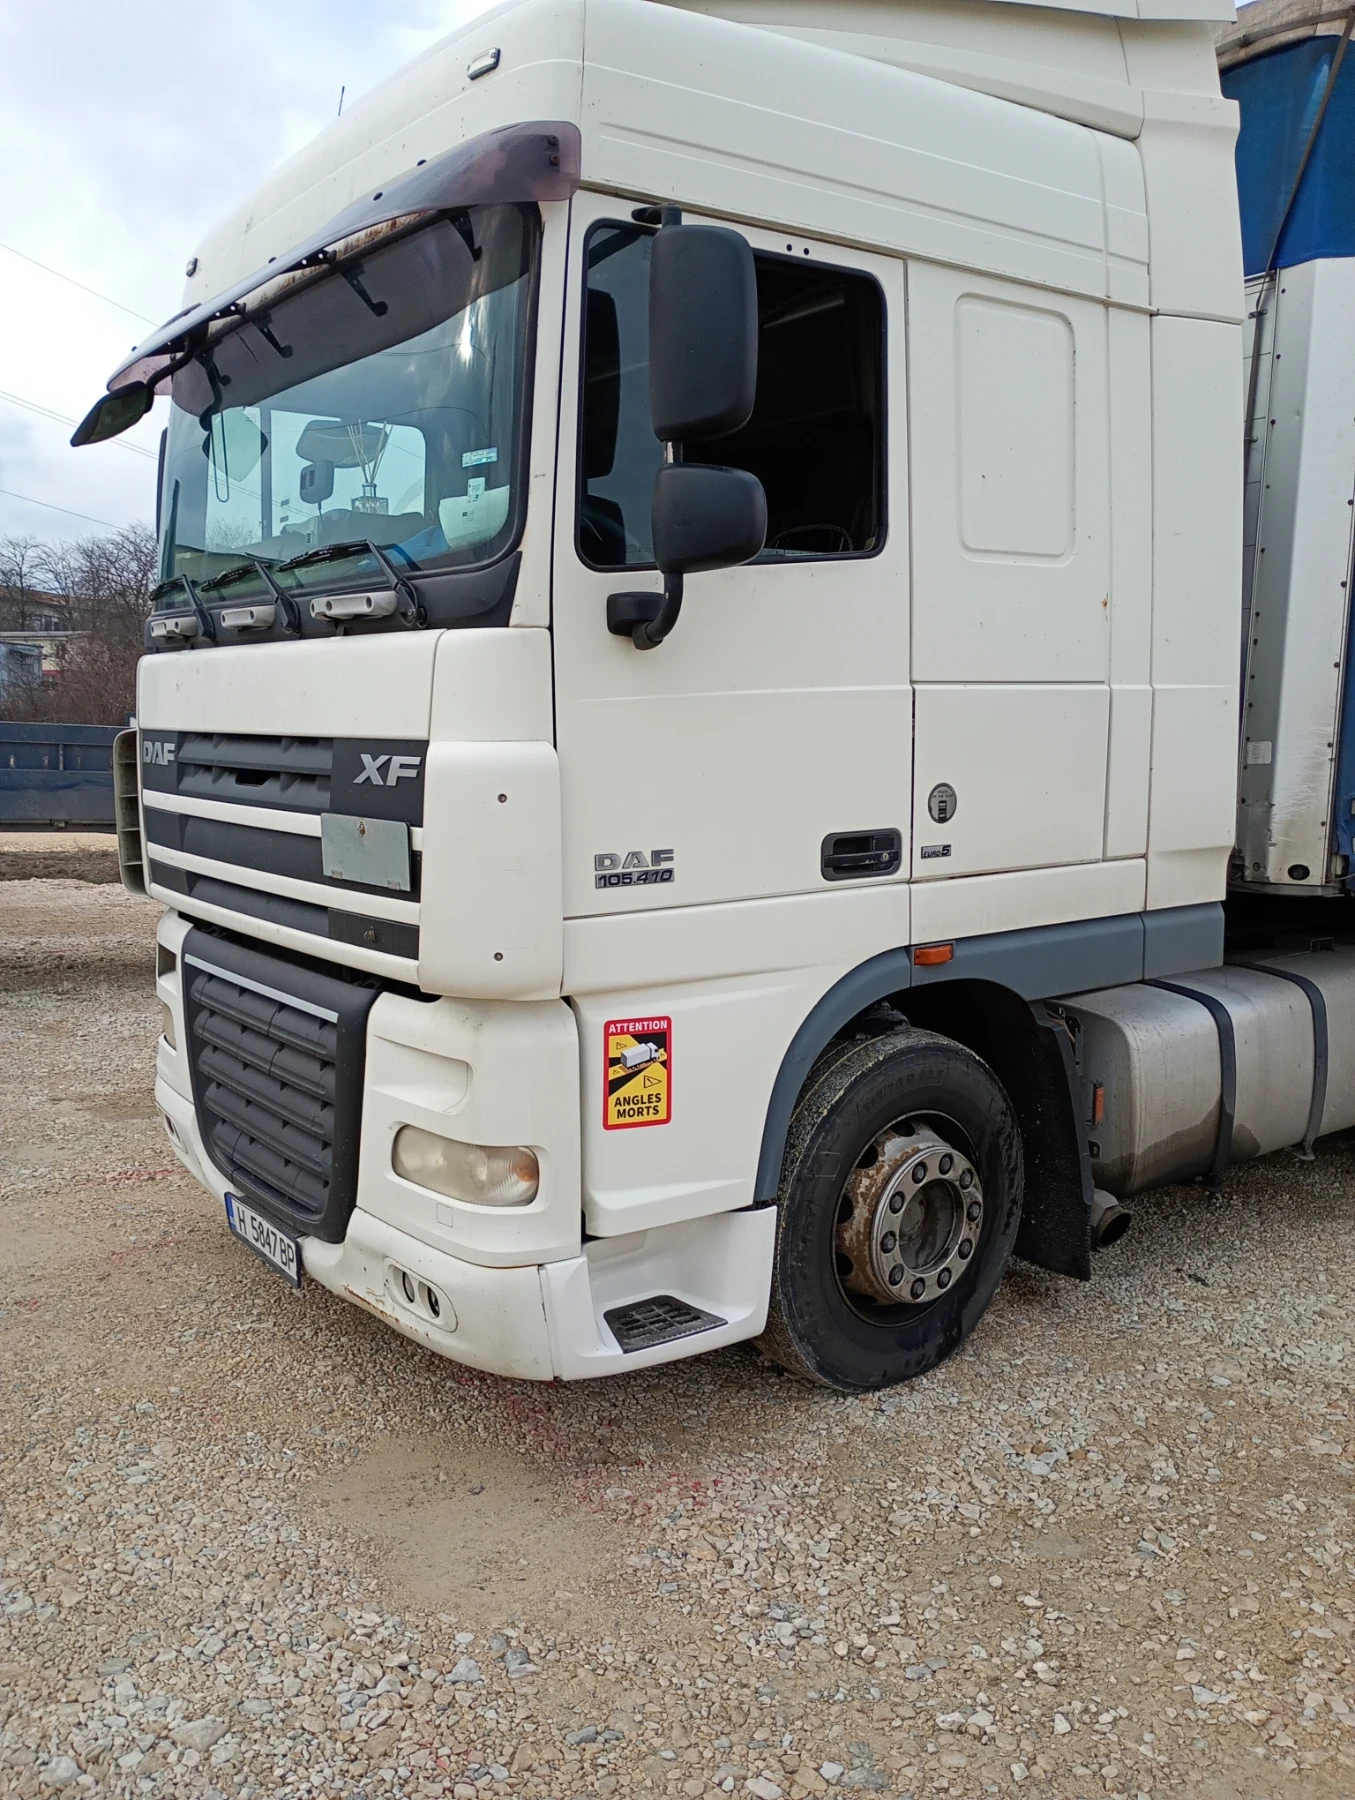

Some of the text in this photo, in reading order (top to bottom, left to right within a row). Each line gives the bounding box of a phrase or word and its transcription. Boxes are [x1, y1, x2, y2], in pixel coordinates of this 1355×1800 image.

[143, 740, 176, 766] DAF
[352, 753, 421, 787] XF
[594, 848, 675, 872] DAF
[598, 869, 674, 887] 105.410
[608, 1019, 668, 1034] ATTENTION
[613, 1093, 662, 1108] ANGLES
[616, 1105, 660, 1119] MORTS
[237, 1206, 294, 1270] H 5847 BP
